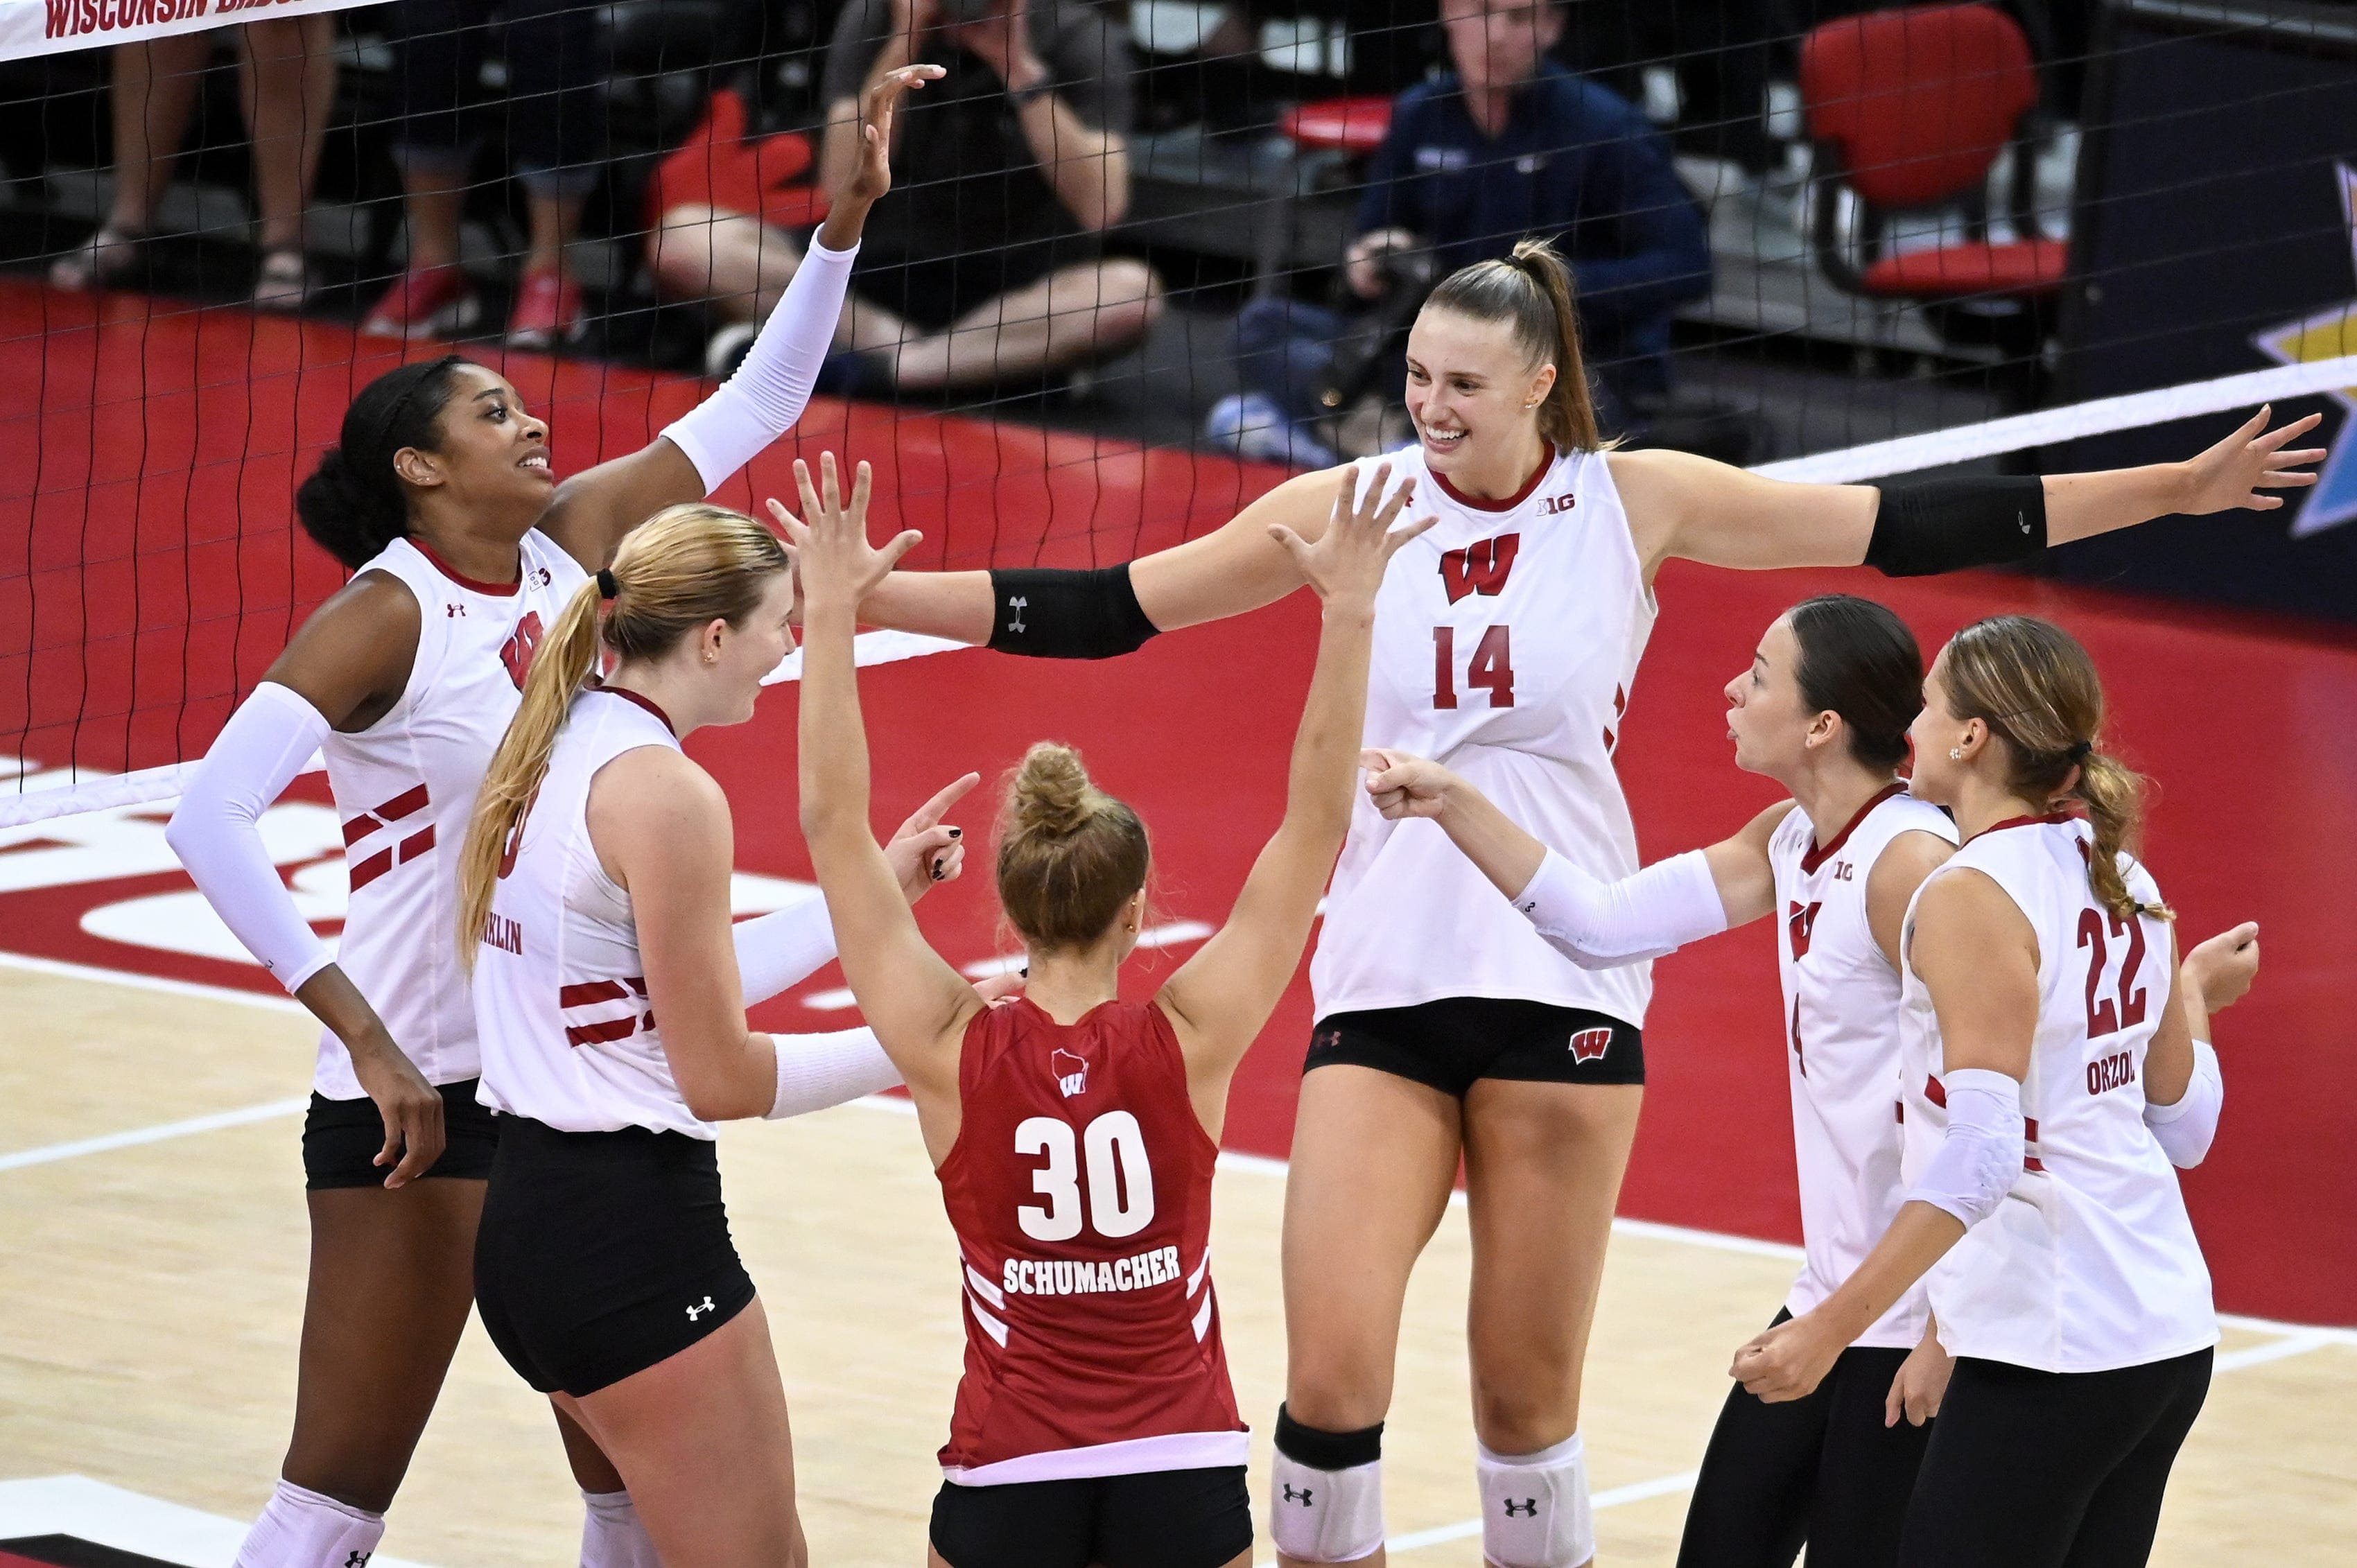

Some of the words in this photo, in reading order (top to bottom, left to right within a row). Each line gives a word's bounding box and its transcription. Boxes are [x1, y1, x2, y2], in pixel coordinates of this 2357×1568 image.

[1437, 532, 1520, 607] W
[1432, 625, 1514, 709] 14
[2077, 908, 2146, 1040] 22
[1567, 1027, 1613, 1065] W
[2086, 1049, 2136, 1096] ORZOL
[1059, 1072, 1084, 1099] W
[1014, 1110, 1155, 1242] 30
[1003, 1245, 1181, 1296] SCHUMACHER
